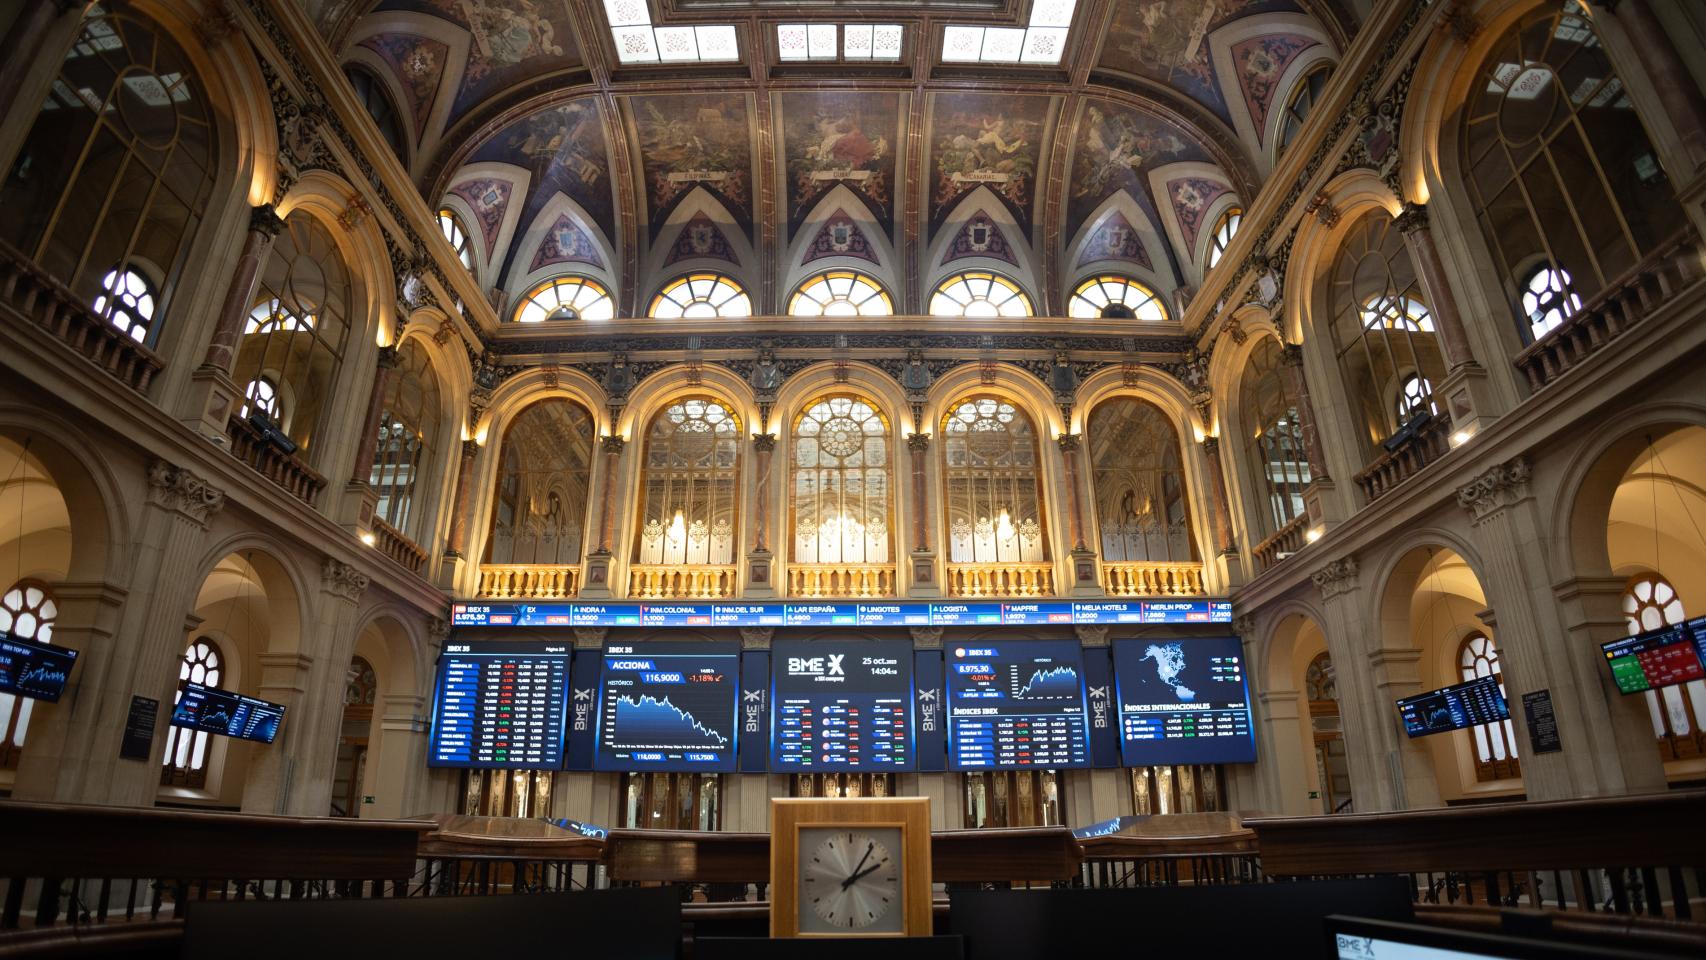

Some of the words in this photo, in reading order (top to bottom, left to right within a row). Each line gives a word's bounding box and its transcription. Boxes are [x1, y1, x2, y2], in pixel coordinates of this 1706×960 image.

[809, 605, 836, 613] ESPAÑA
[612, 661, 650, 669] ACCIONA
[788, 657, 825, 672] BME
[862, 657, 872, 665] 25
[959, 665, 989, 674] 8.975,30
[645, 674, 680, 682] 116,9000
[953, 707, 981, 715] ÍNDICES
[1124, 704, 1151, 712] ÍNDICES
[1151, 703, 1210, 711] INTERNACIONALES
[574, 703, 587, 730] BME
[746, 705, 758, 732] BME
[921, 704, 934, 731] BME
[1092, 701, 1106, 728] BME
[1337, 936, 1361, 951] BME
